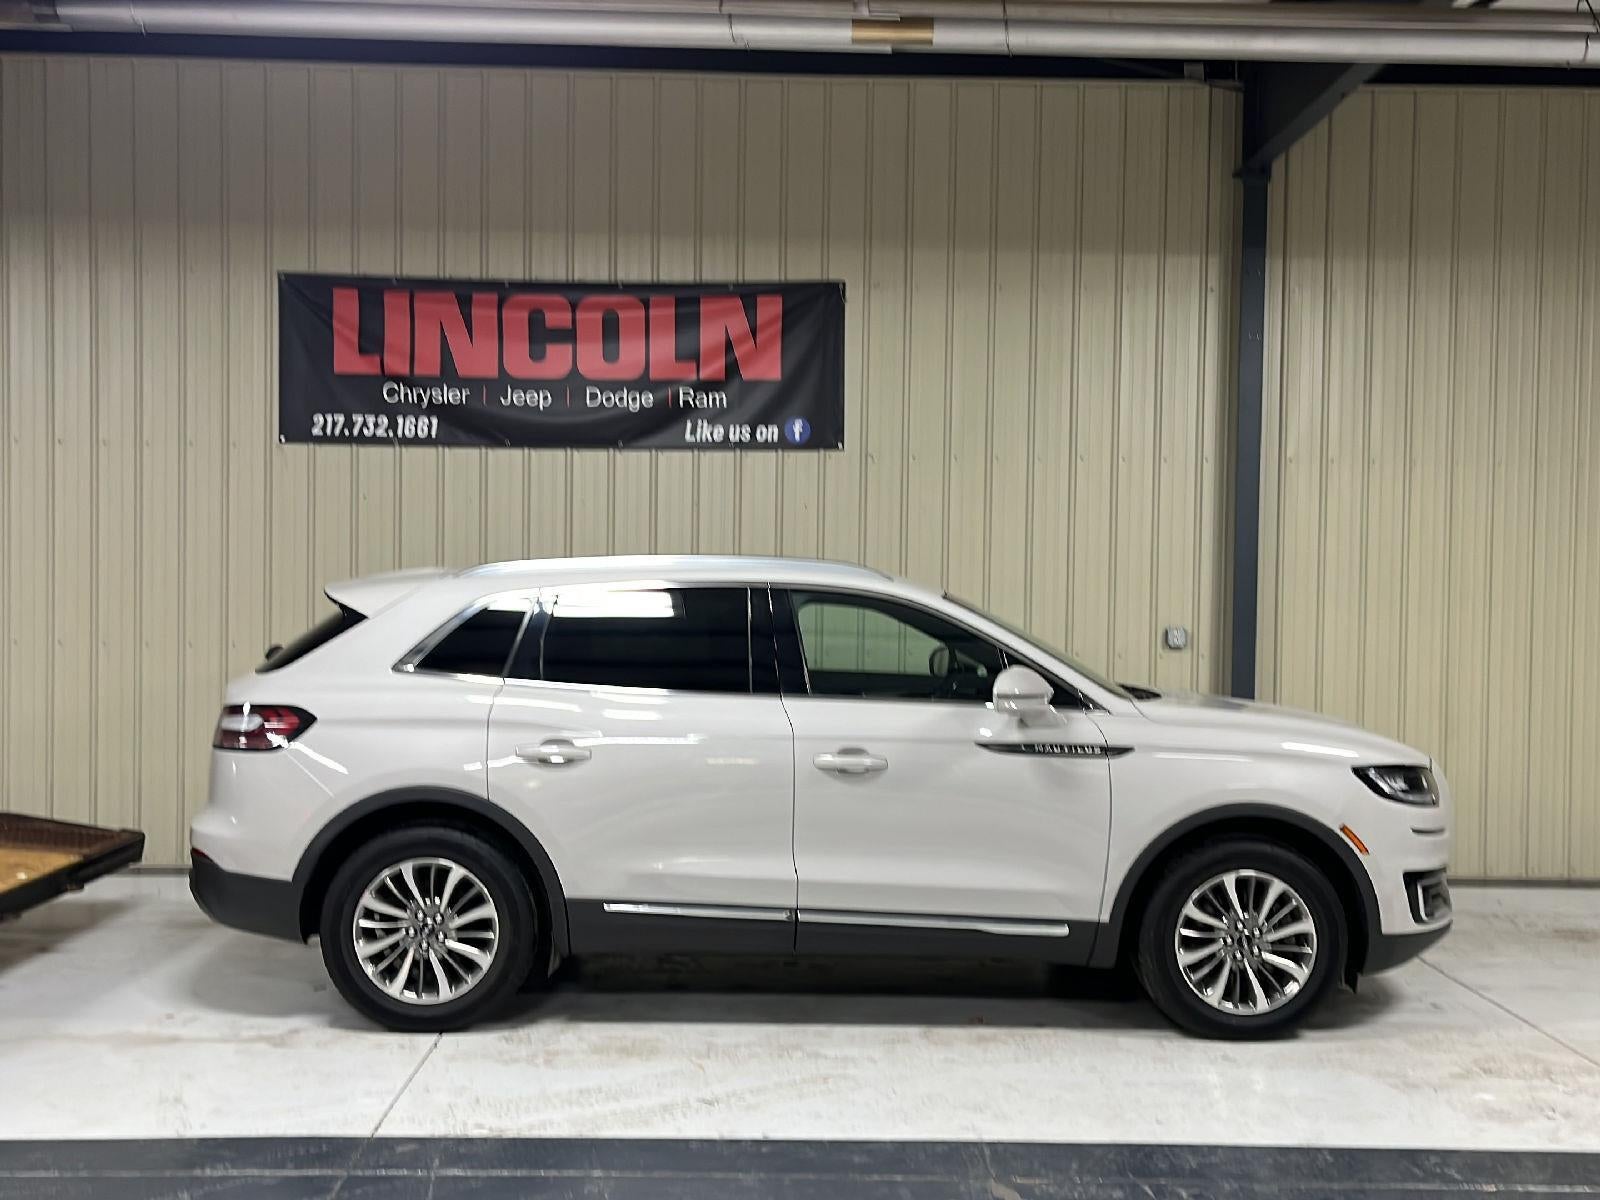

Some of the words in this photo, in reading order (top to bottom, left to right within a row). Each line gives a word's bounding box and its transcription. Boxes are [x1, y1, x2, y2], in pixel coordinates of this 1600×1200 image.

[332, 287, 783, 382] LINCOLN
[382, 381, 470, 409] Chrysler
[500, 384, 552, 411] Jeep
[585, 385, 654, 412] Dodge
[678, 386, 728, 409] Ram
[311, 413, 439, 439] 217.732.1661
[684, 418, 725, 443] Like
[728, 424, 752, 443] us
[755, 424, 779, 443] on
